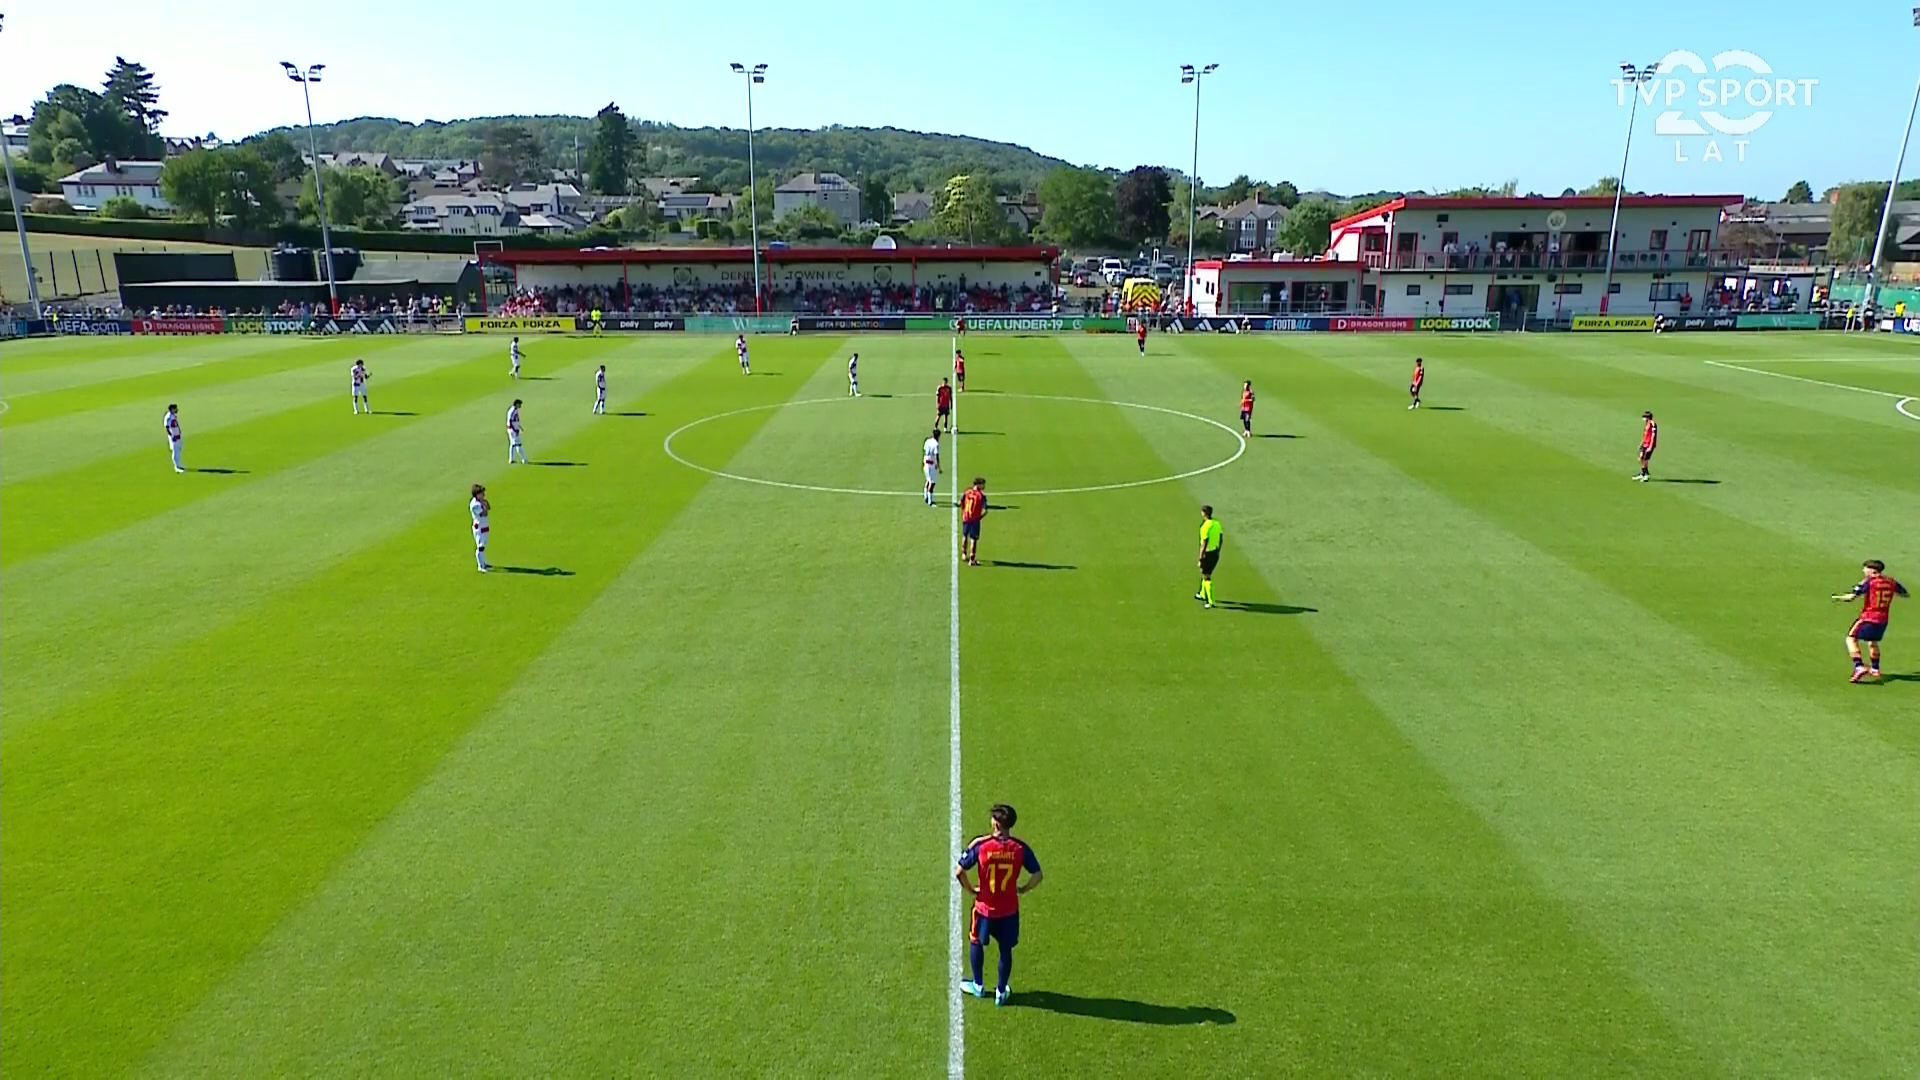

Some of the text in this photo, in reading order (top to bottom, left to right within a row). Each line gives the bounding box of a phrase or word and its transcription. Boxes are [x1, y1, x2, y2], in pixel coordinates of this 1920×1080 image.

[788, 270, 824, 280] TOWN
[54, 319, 120, 334] UEFA.com
[231, 320, 305, 332] LOCKSTOCK
[480, 319, 561, 329] FORZA FORZA
[968, 318, 1063, 330] UEFA UNDER-19
[1264, 319, 1312, 330] #FOOTBALL
[1420, 318, 1492, 329] LOCKSTOCK
[1578, 319, 1648, 328] FORZA FORZA
[988, 863, 1014, 894] 17
